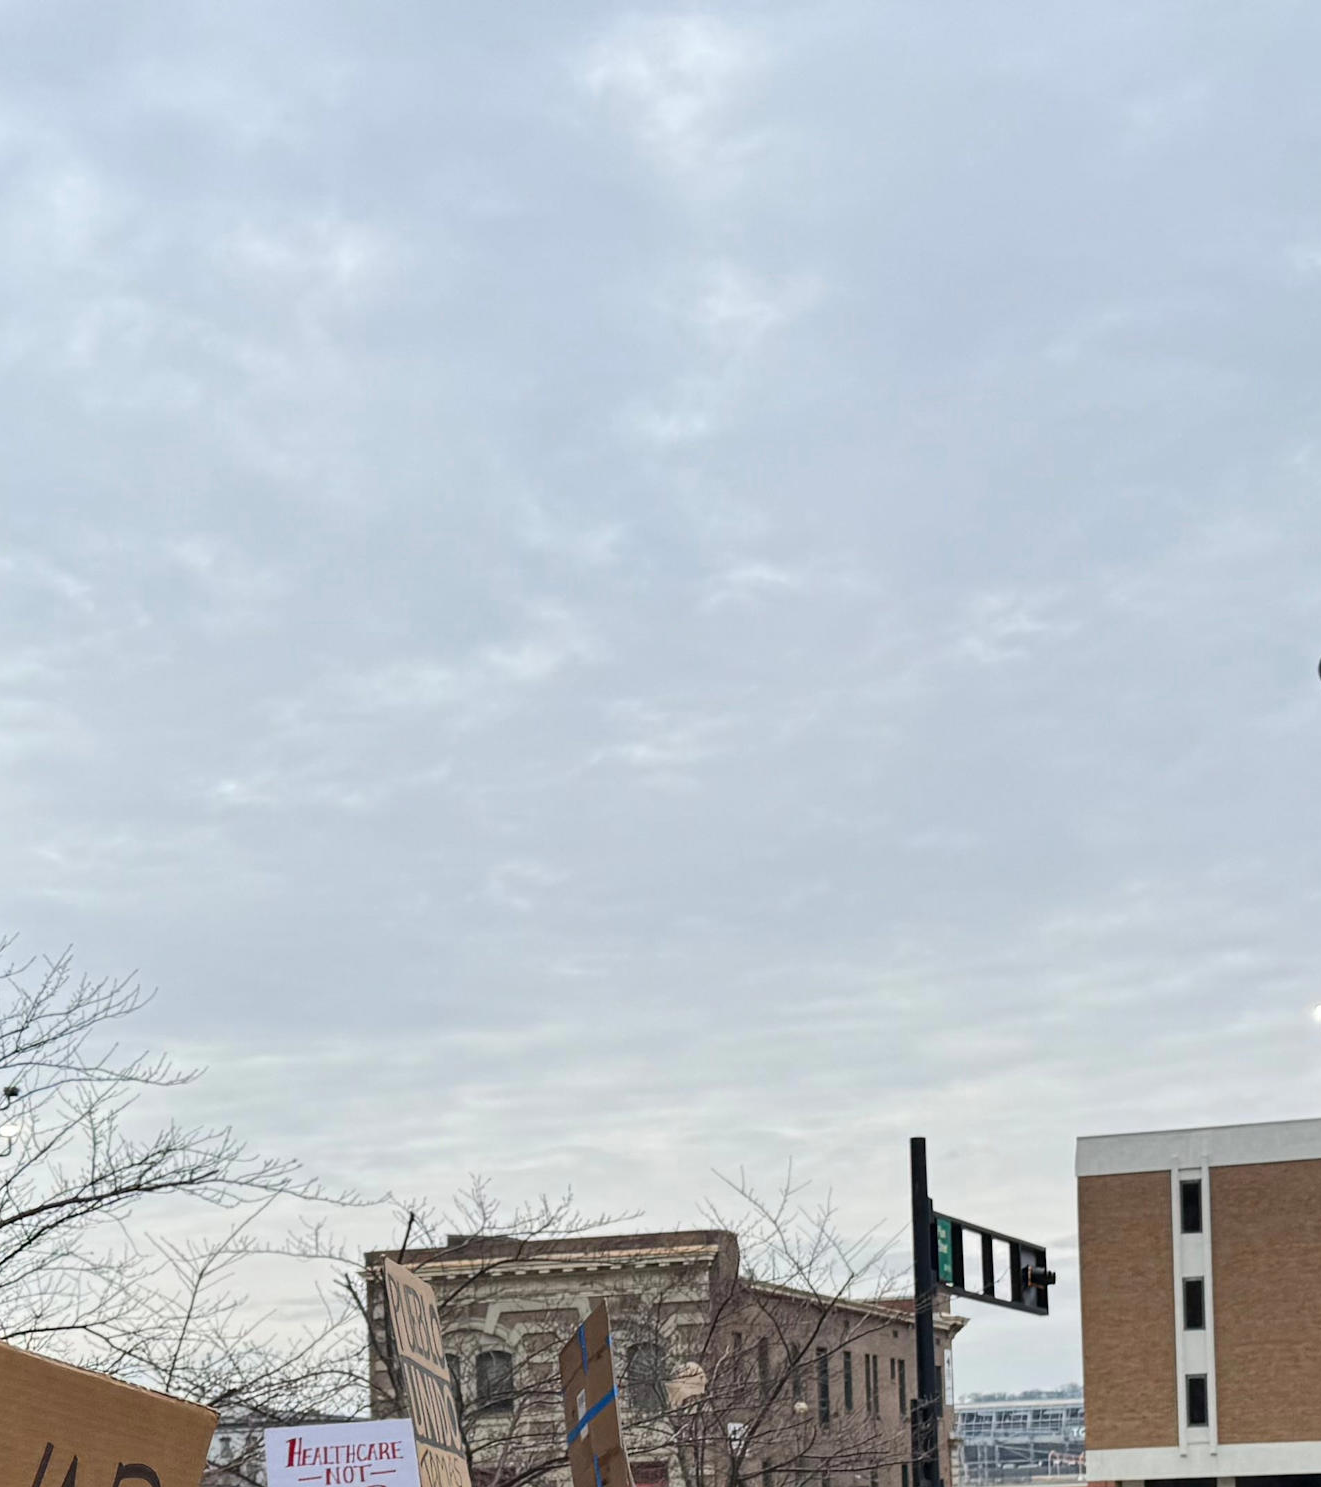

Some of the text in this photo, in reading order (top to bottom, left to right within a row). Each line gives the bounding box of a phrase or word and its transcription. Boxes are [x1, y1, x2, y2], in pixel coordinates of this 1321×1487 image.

[387, 1274, 445, 1370] PUEBLO
[403, 1362, 460, 1449] UNIDO
[285, 1437, 404, 1468] HEALTHCARE
[325, 1464, 372, 1486] NOT
